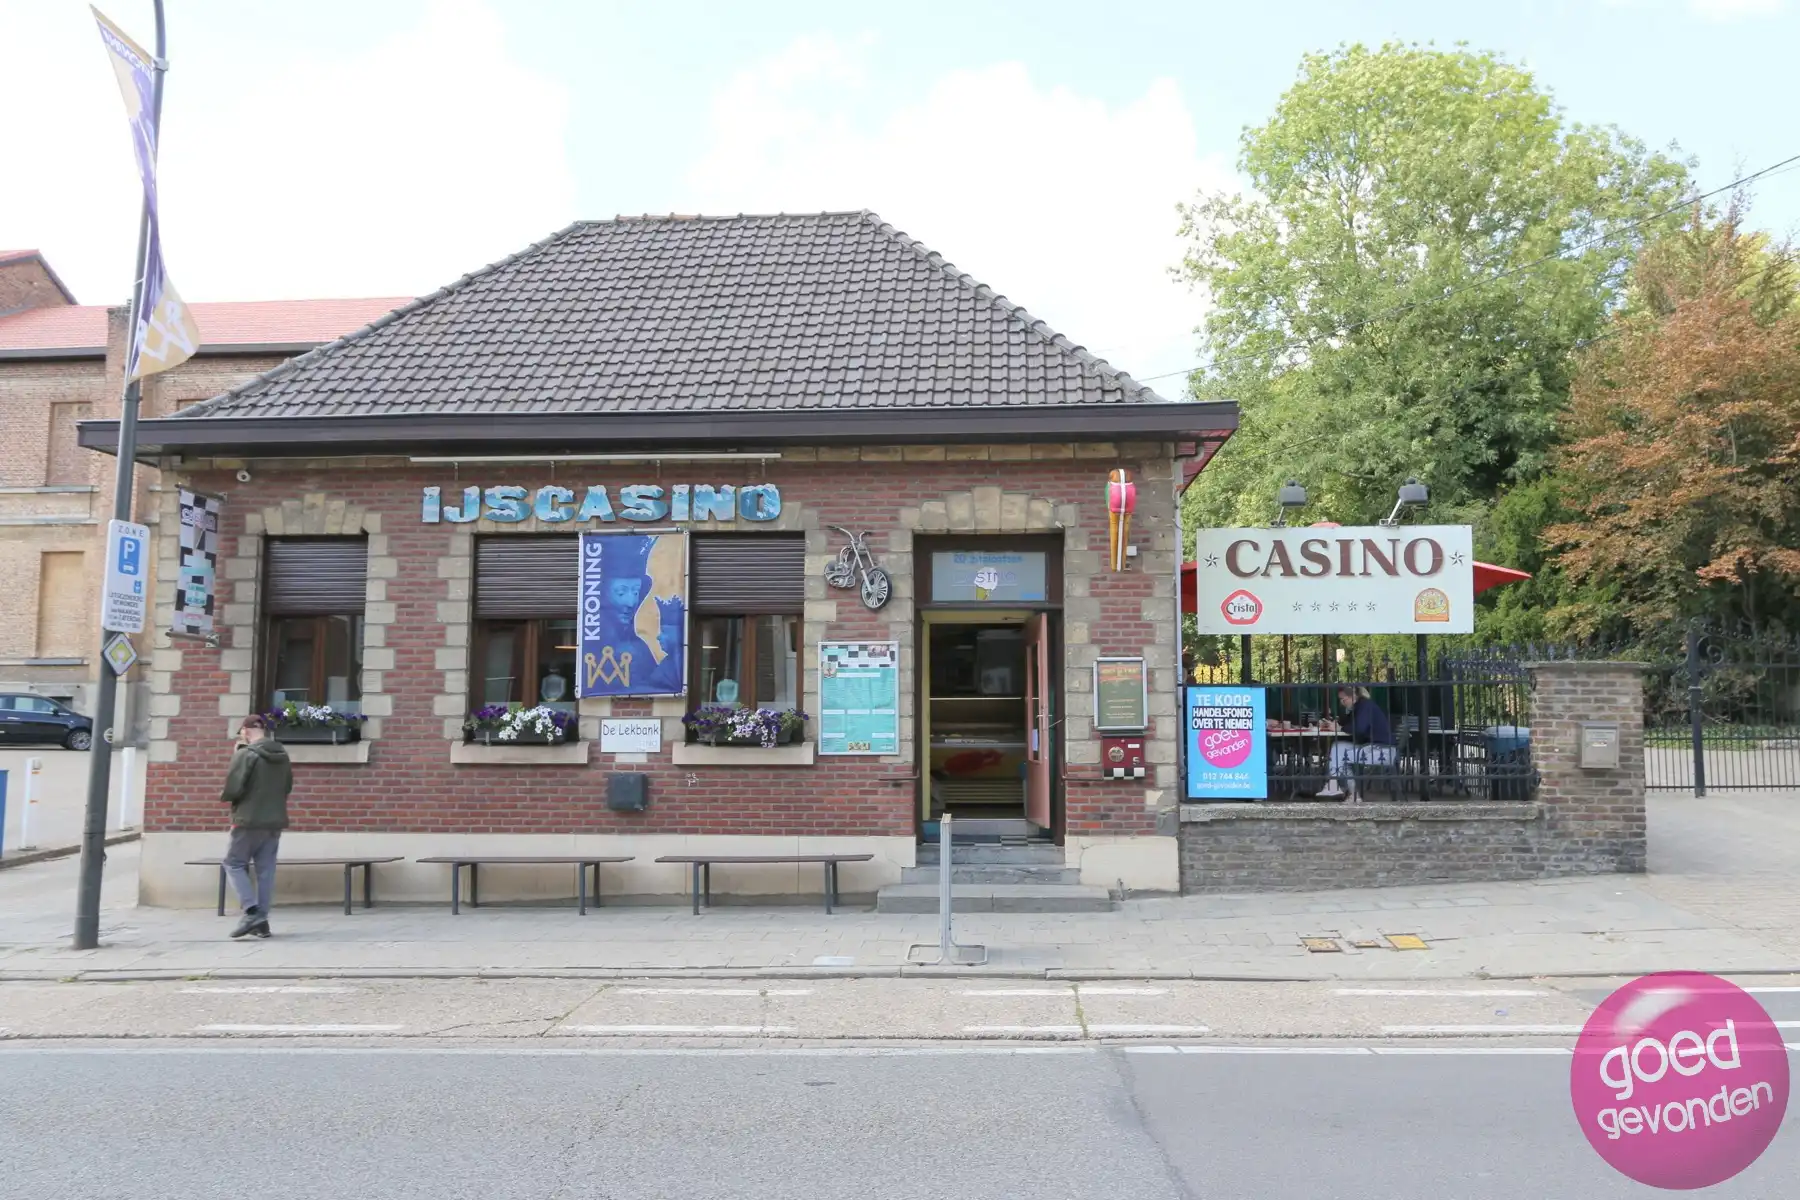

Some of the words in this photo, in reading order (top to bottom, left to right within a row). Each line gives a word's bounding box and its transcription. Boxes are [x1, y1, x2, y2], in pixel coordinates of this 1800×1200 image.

[422, 483, 782, 524] IJSCASINO
[118, 525, 145, 538] ZONE
[1225, 537, 1444, 578] CASINO
[584, 541, 604, 641] KRONING
[1226, 601, 1258, 615] Cristal
[1195, 694, 1211, 706] TE
[1214, 694, 1252, 706] KOOP
[1192, 707, 1253, 718] HANDELSFONDS
[603, 724, 616, 736] De
[618, 723, 659, 736] Lekbank
[1192, 718, 1214, 729] OVER
[1214, 718, 1223, 729] TE
[1225, 718, 1253, 729] NEMEN
[1206, 737, 1249, 760] gevonden
